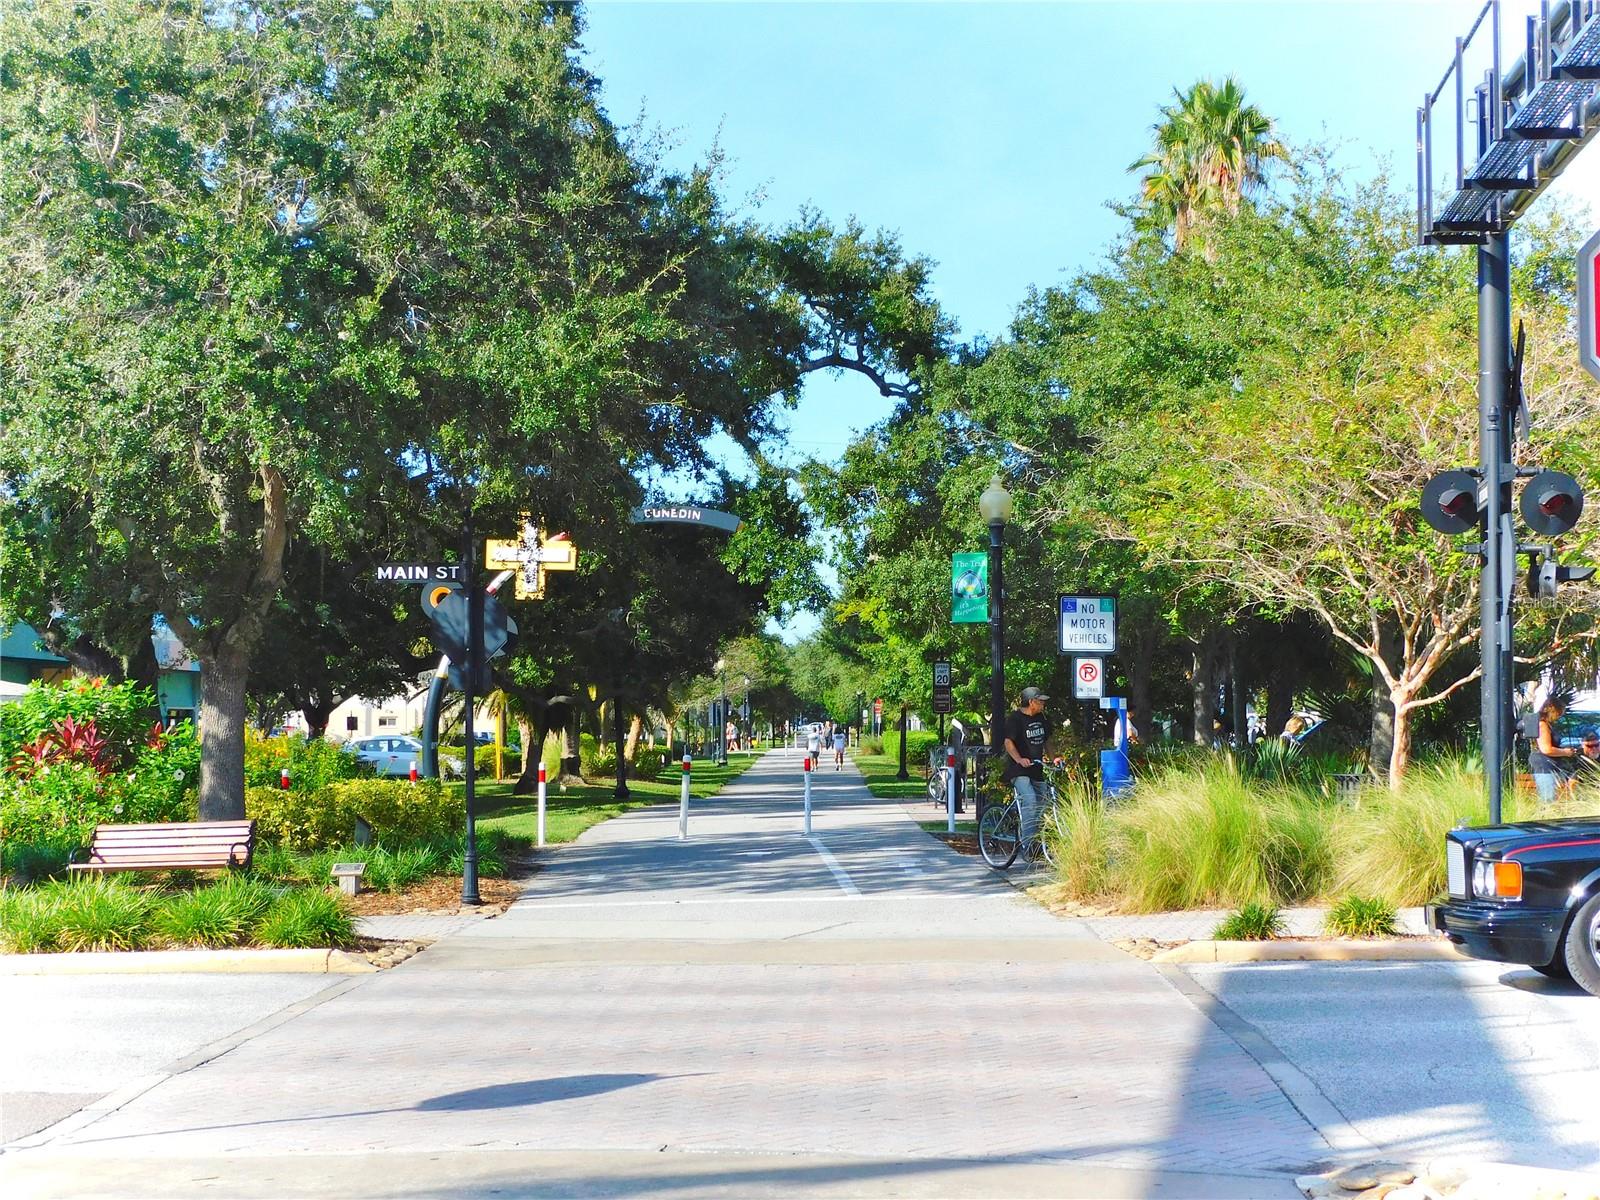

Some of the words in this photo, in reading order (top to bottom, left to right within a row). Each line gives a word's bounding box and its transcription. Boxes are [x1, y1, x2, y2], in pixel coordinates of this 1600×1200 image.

[377, 566, 428, 579] MAIN
[435, 566, 460, 579] ST
[1081, 603, 1095, 614] NO
[1071, 618, 1105, 629] MOTOR
[1069, 633, 1107, 644] VEHICLES
[936, 674, 948, 684] 20
